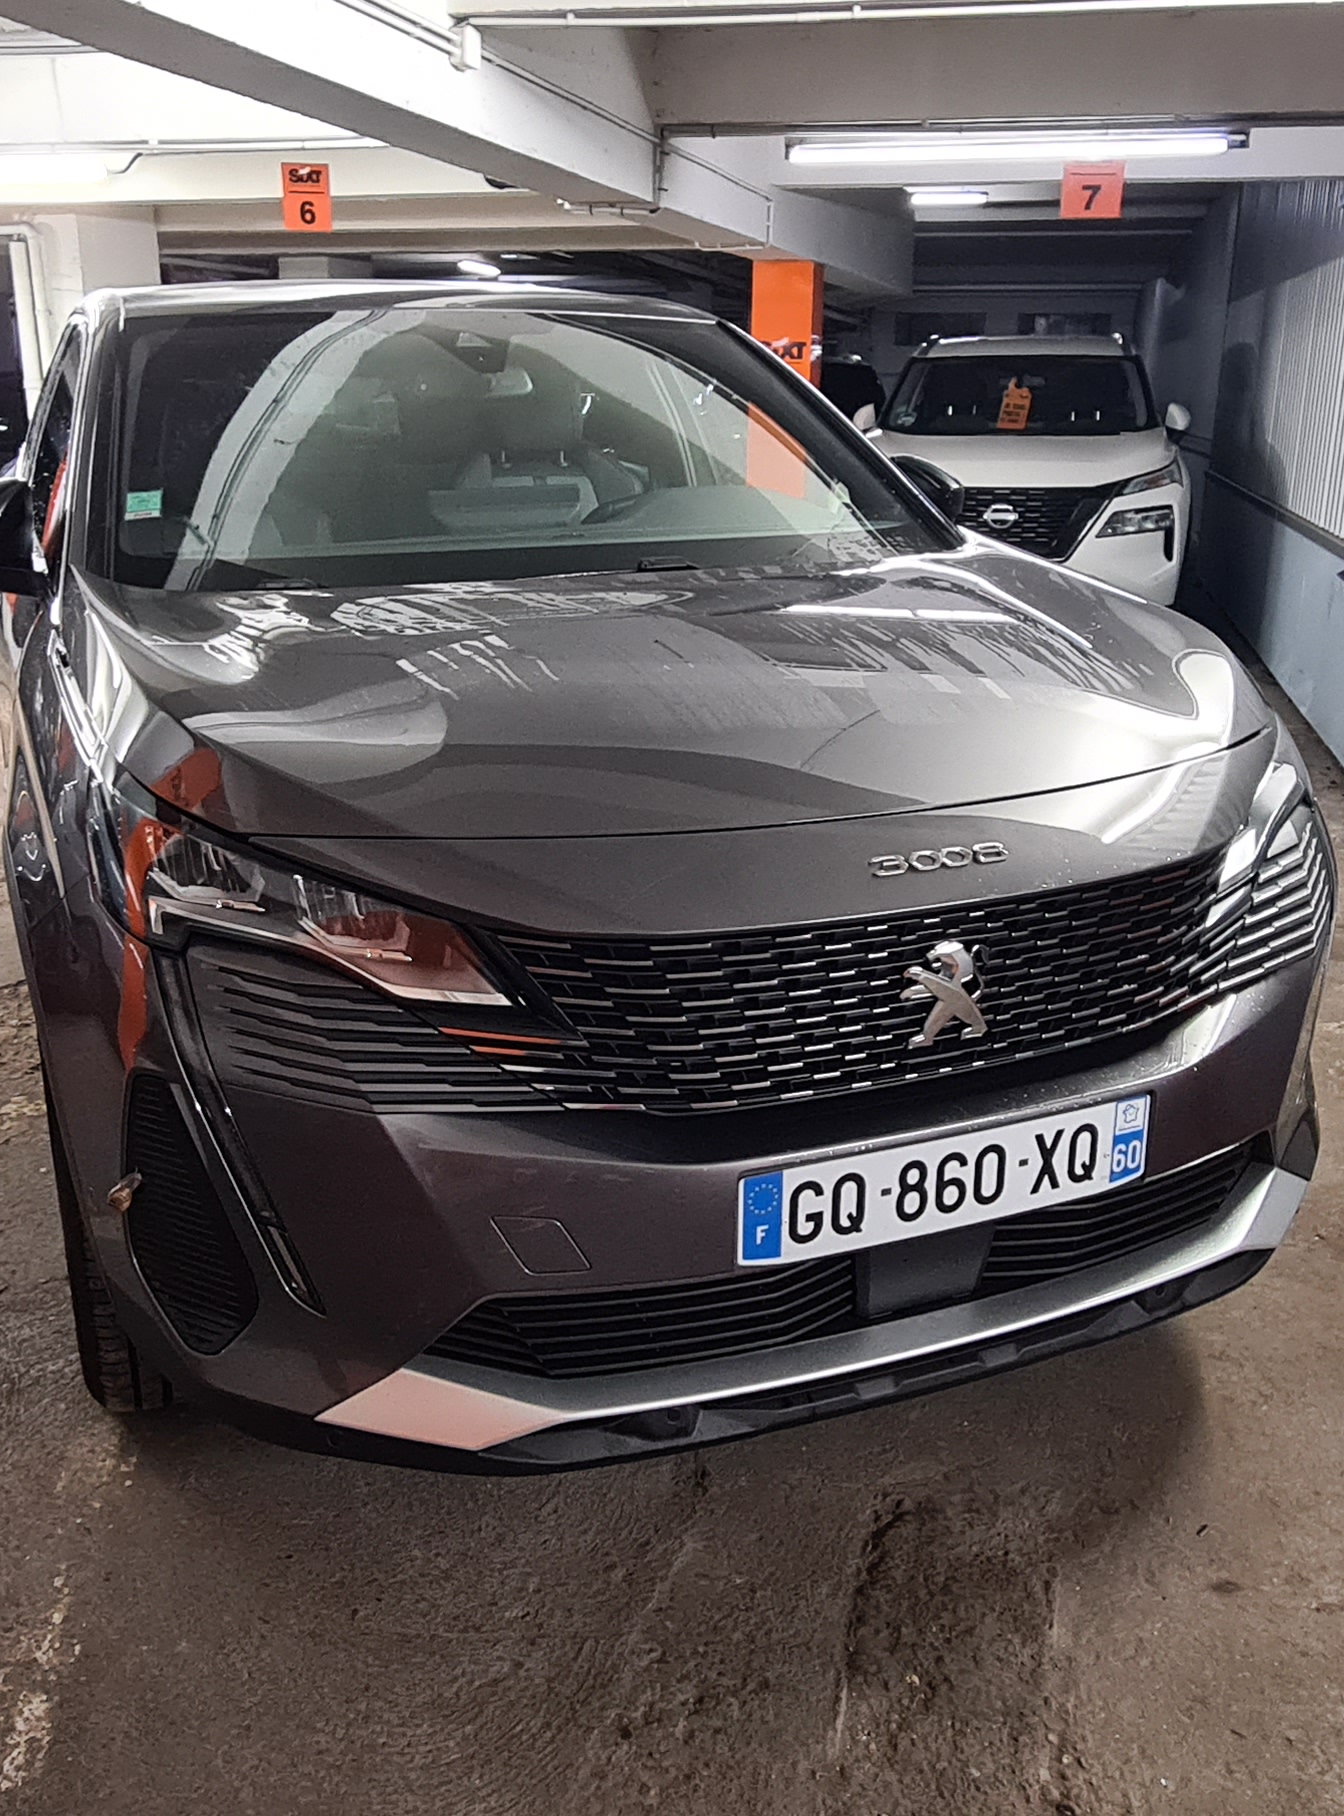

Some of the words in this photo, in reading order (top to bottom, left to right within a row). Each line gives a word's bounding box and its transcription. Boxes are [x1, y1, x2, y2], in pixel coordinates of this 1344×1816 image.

[299, 200, 317, 225] 6
[1082, 184, 1102, 211] 7
[868, 841, 1009, 878] 3008
[1112, 1140, 1142, 1173] 60
[787, 1123, 1099, 1244] GQ-860-XQ
[756, 1225, 768, 1244] F
